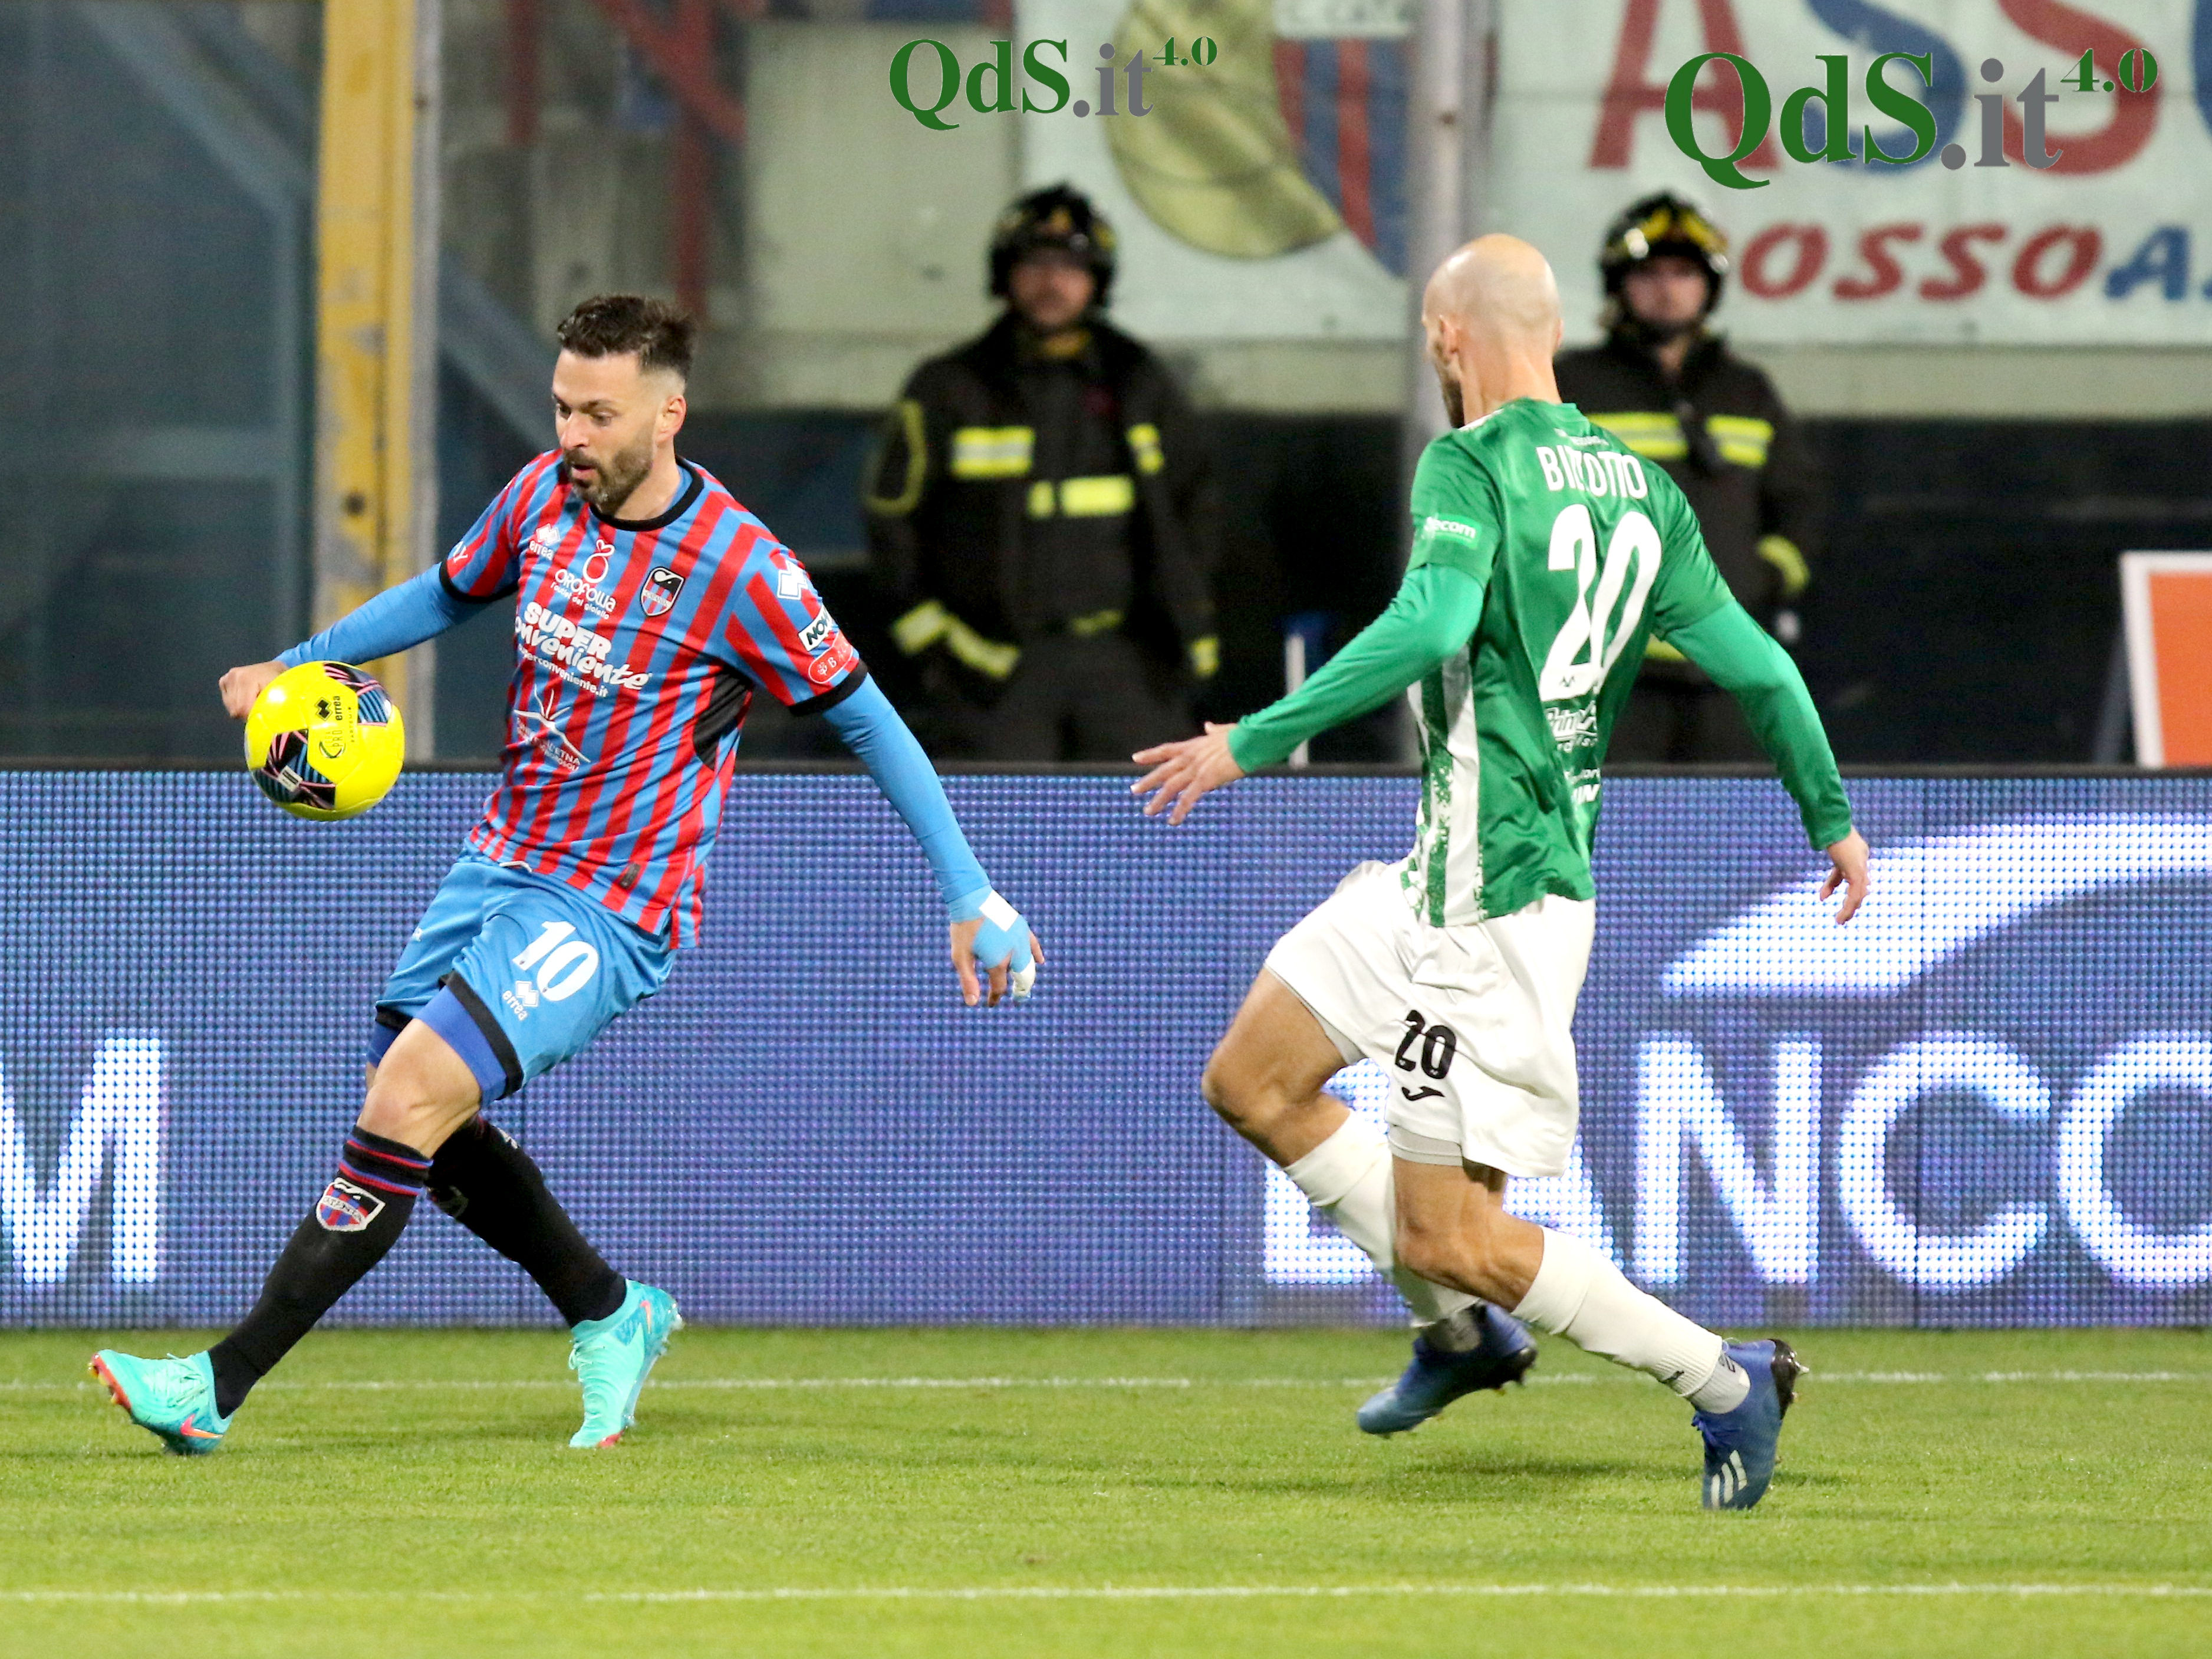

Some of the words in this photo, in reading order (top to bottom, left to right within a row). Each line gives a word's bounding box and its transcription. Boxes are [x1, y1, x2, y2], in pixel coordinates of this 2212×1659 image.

[1588, 0, 2212, 178] ASS
[524, 601, 611, 661] SUPER
[1539, 503, 1661, 702] 20
[515, 616, 652, 690] onveniente
[512, 921, 599, 1002] 10
[1395, 1010, 1456, 1079] 20
